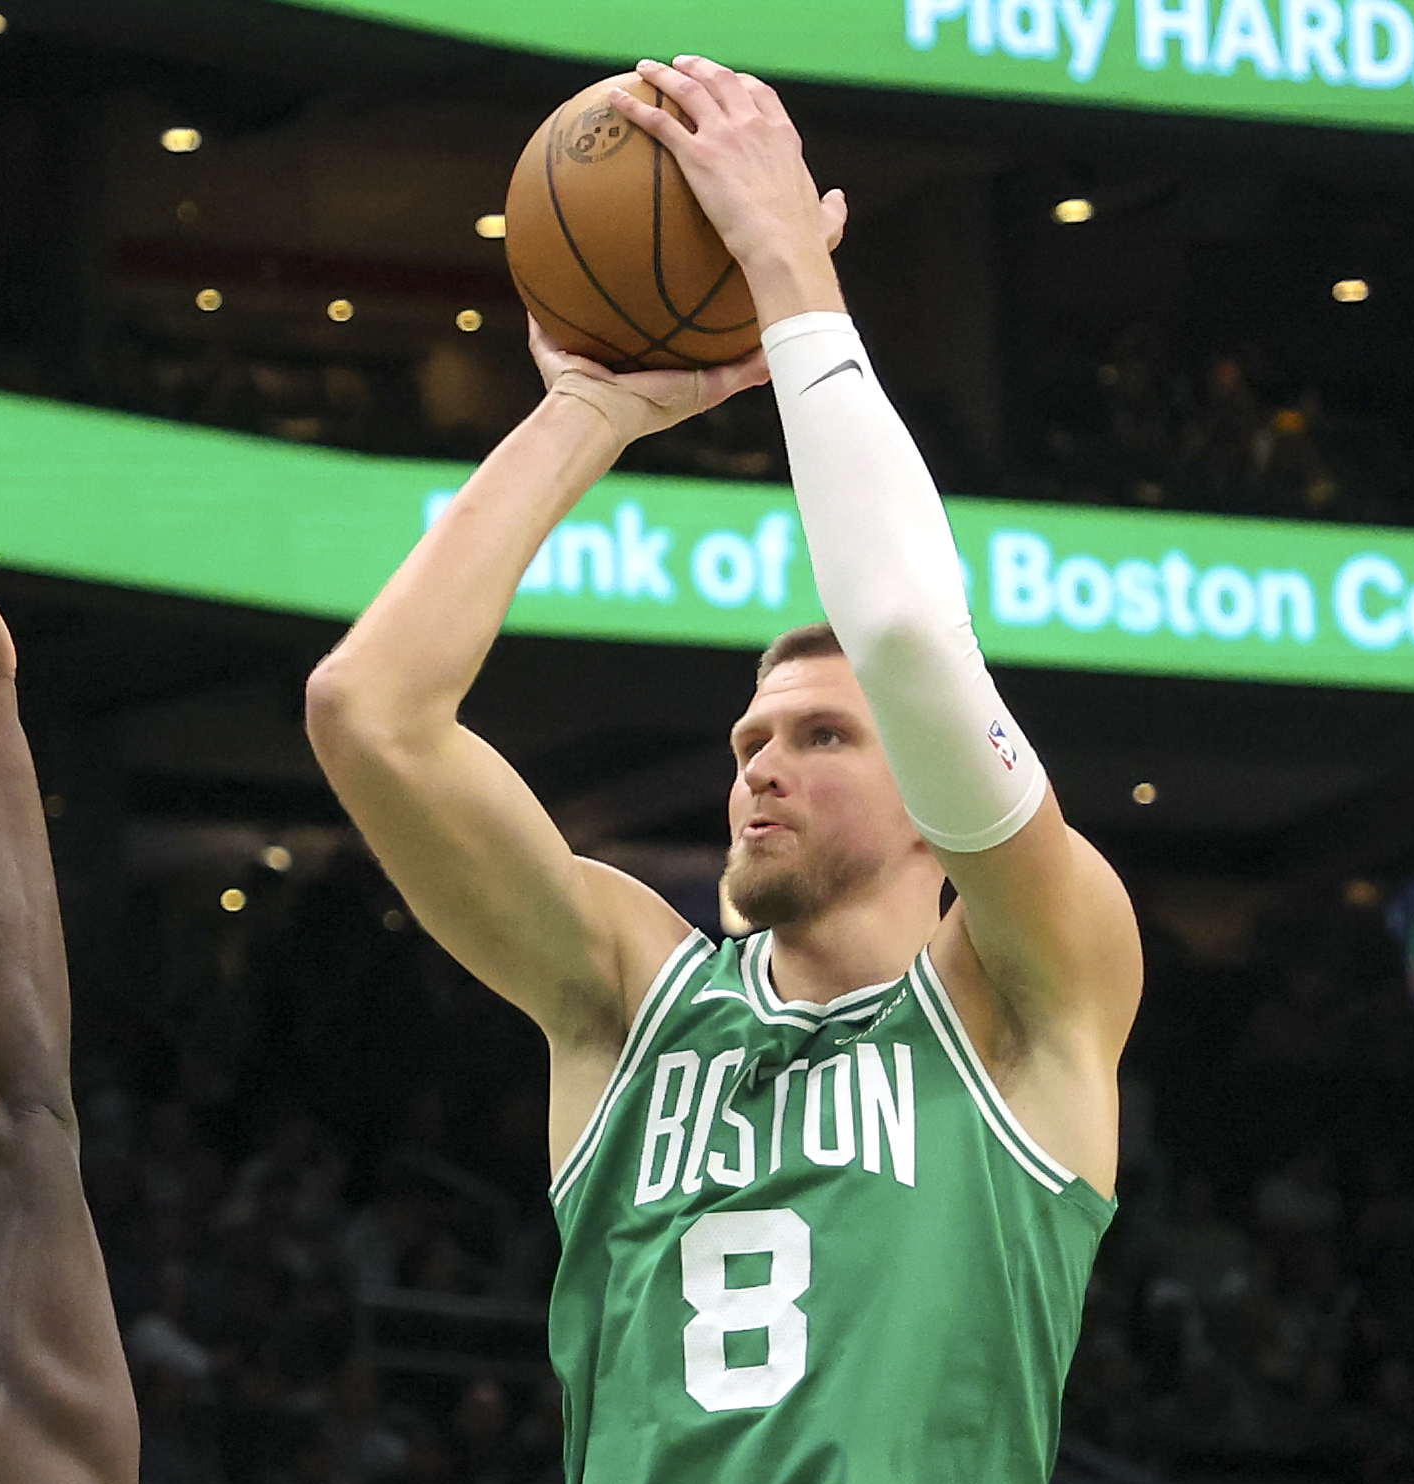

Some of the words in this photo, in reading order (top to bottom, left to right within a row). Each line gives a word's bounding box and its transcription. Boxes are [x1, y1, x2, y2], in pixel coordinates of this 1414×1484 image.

[690, 510, 797, 610] of
[988, 528, 1316, 643] Boston
[634, 1043, 916, 1206] BOSTON
[680, 1207, 813, 1412] 8
